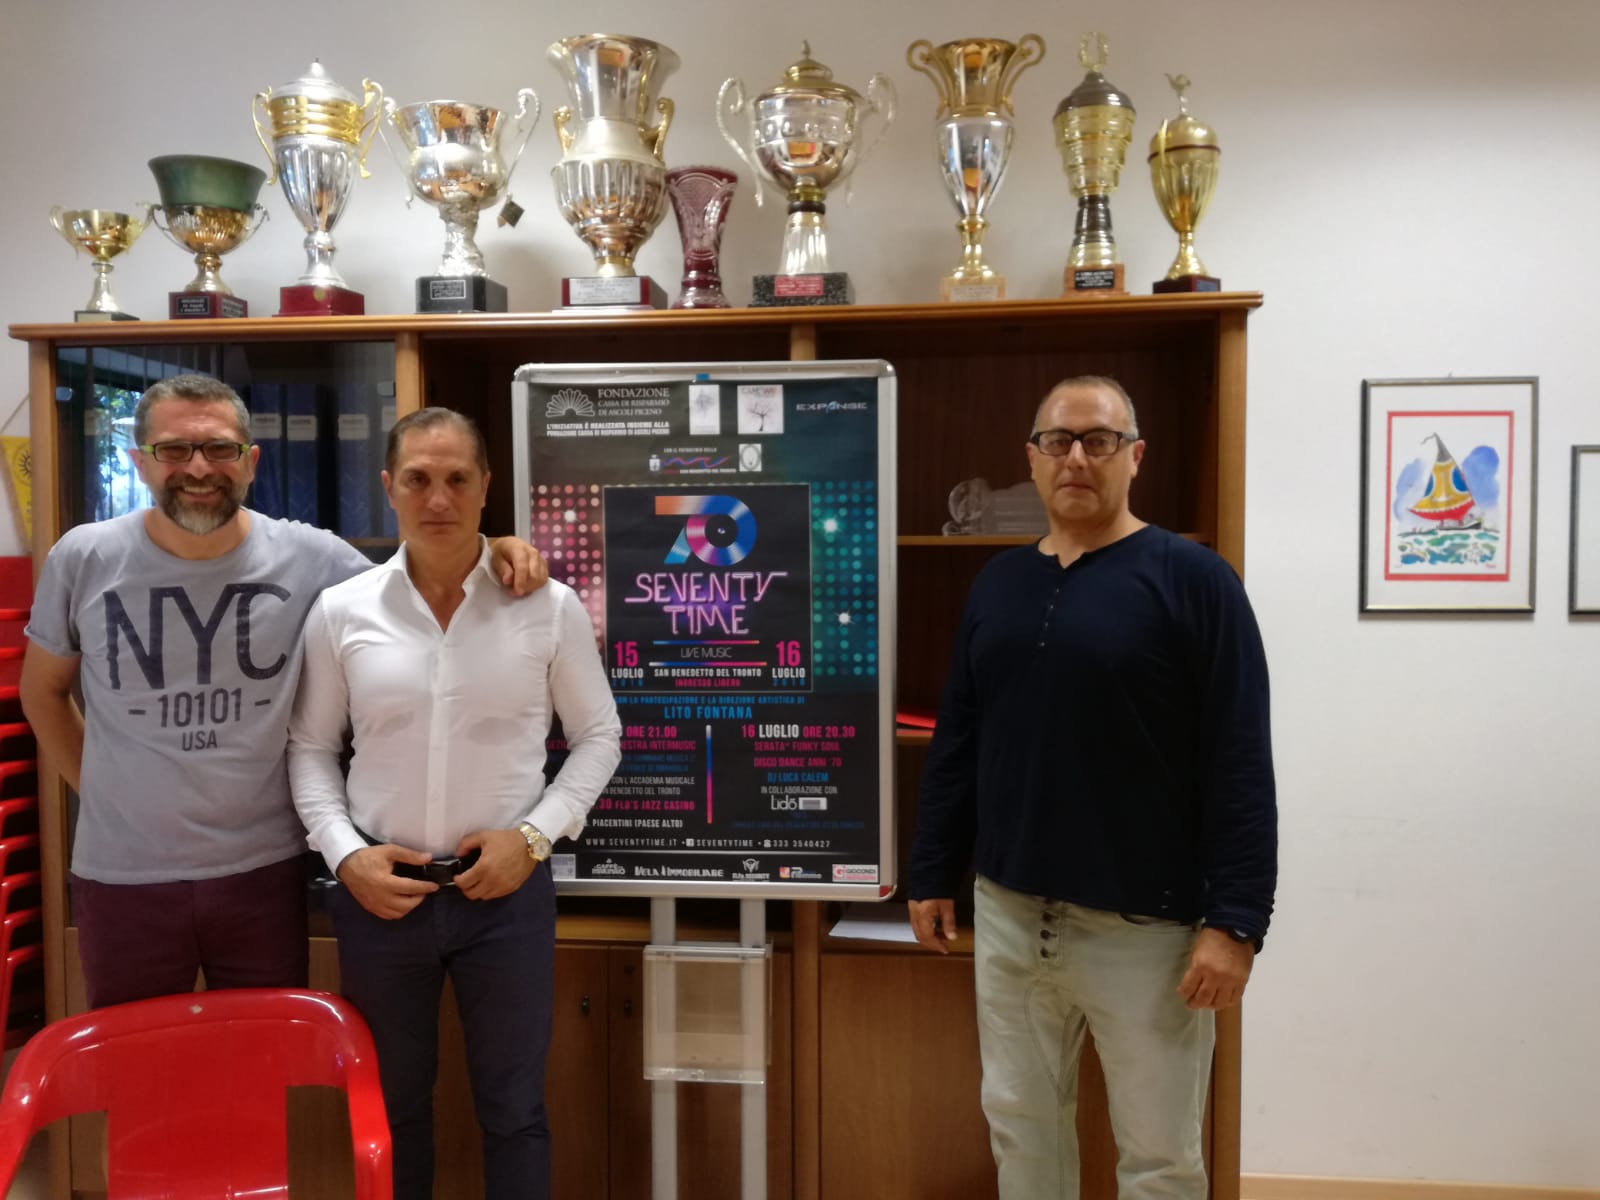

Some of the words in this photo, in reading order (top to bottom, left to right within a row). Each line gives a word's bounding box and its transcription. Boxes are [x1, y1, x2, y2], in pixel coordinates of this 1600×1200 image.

[598, 388, 670, 398] FONDAZIONE
[655, 495, 758, 566] 70
[624, 571, 788, 603] SEVENTY
[663, 605, 749, 635] TIME
[103, 583, 291, 690] NYC
[614, 640, 639, 667] 15
[680, 647, 700, 658] LIVE
[701, 647, 733, 658] MUSIC
[776, 640, 801, 667] 16
[611, 667, 644, 679] LUGLIO
[654, 668, 669, 677] SAN
[671, 668, 714, 677] BENEDETTO
[716, 668, 730, 677] DEL
[733, 667, 762, 677] TRONTO
[772, 667, 806, 678] LUGLIO
[675, 678, 711, 687] INGRESSO
[714, 678, 741, 687] LIBERO
[640, 695, 698, 704] PARTECIPAZIONE
[700, 696, 705, 704] E
[707, 696, 717, 704] LA
[719, 695, 755, 704] DIREZIONE
[758, 695, 794, 704] ARTISTICA
[797, 695, 806, 704] DI
[157, 688, 242, 727] 10101
[664, 706, 692, 719] LITO
[696, 706, 752, 719] FONTANA
[626, 726, 645, 738] ORE
[647, 726, 677, 738] 21.00
[742, 724, 755, 738] 16
[759, 724, 800, 738] LUGLIO
[803, 726, 822, 738] ORE
[825, 725, 856, 738] 20.30
[182, 730, 218, 751] USA
[650, 741, 696, 750] INTERMUSIC
[792, 741, 819, 751] FUNKY
[821, 741, 840, 751] SOUL
[754, 757, 777, 767] DISCO
[779, 757, 805, 767] DANCE
[807, 757, 827, 767] ANNI
[665, 776, 696, 785] MUSICALE
[610, 786, 643, 795] BENEDETTO
[644, 787, 657, 795] DEL
[657, 787, 681, 795] TRONTO
[768, 786, 823, 794] COLLABORAZIONE
[824, 786, 838, 794] CON
[641, 801, 661, 811] JAZZ
[663, 801, 696, 811] CASINO
[592, 819, 633, 827] PIACENTINI
[635, 819, 660, 828] (PAESE
[661, 819, 684, 828] ALTO)
[697, 838, 753, 847] SEVENTYTIME
[634, 866, 659, 876] VELA
[666, 867, 724, 877] IMMOBILIARE
